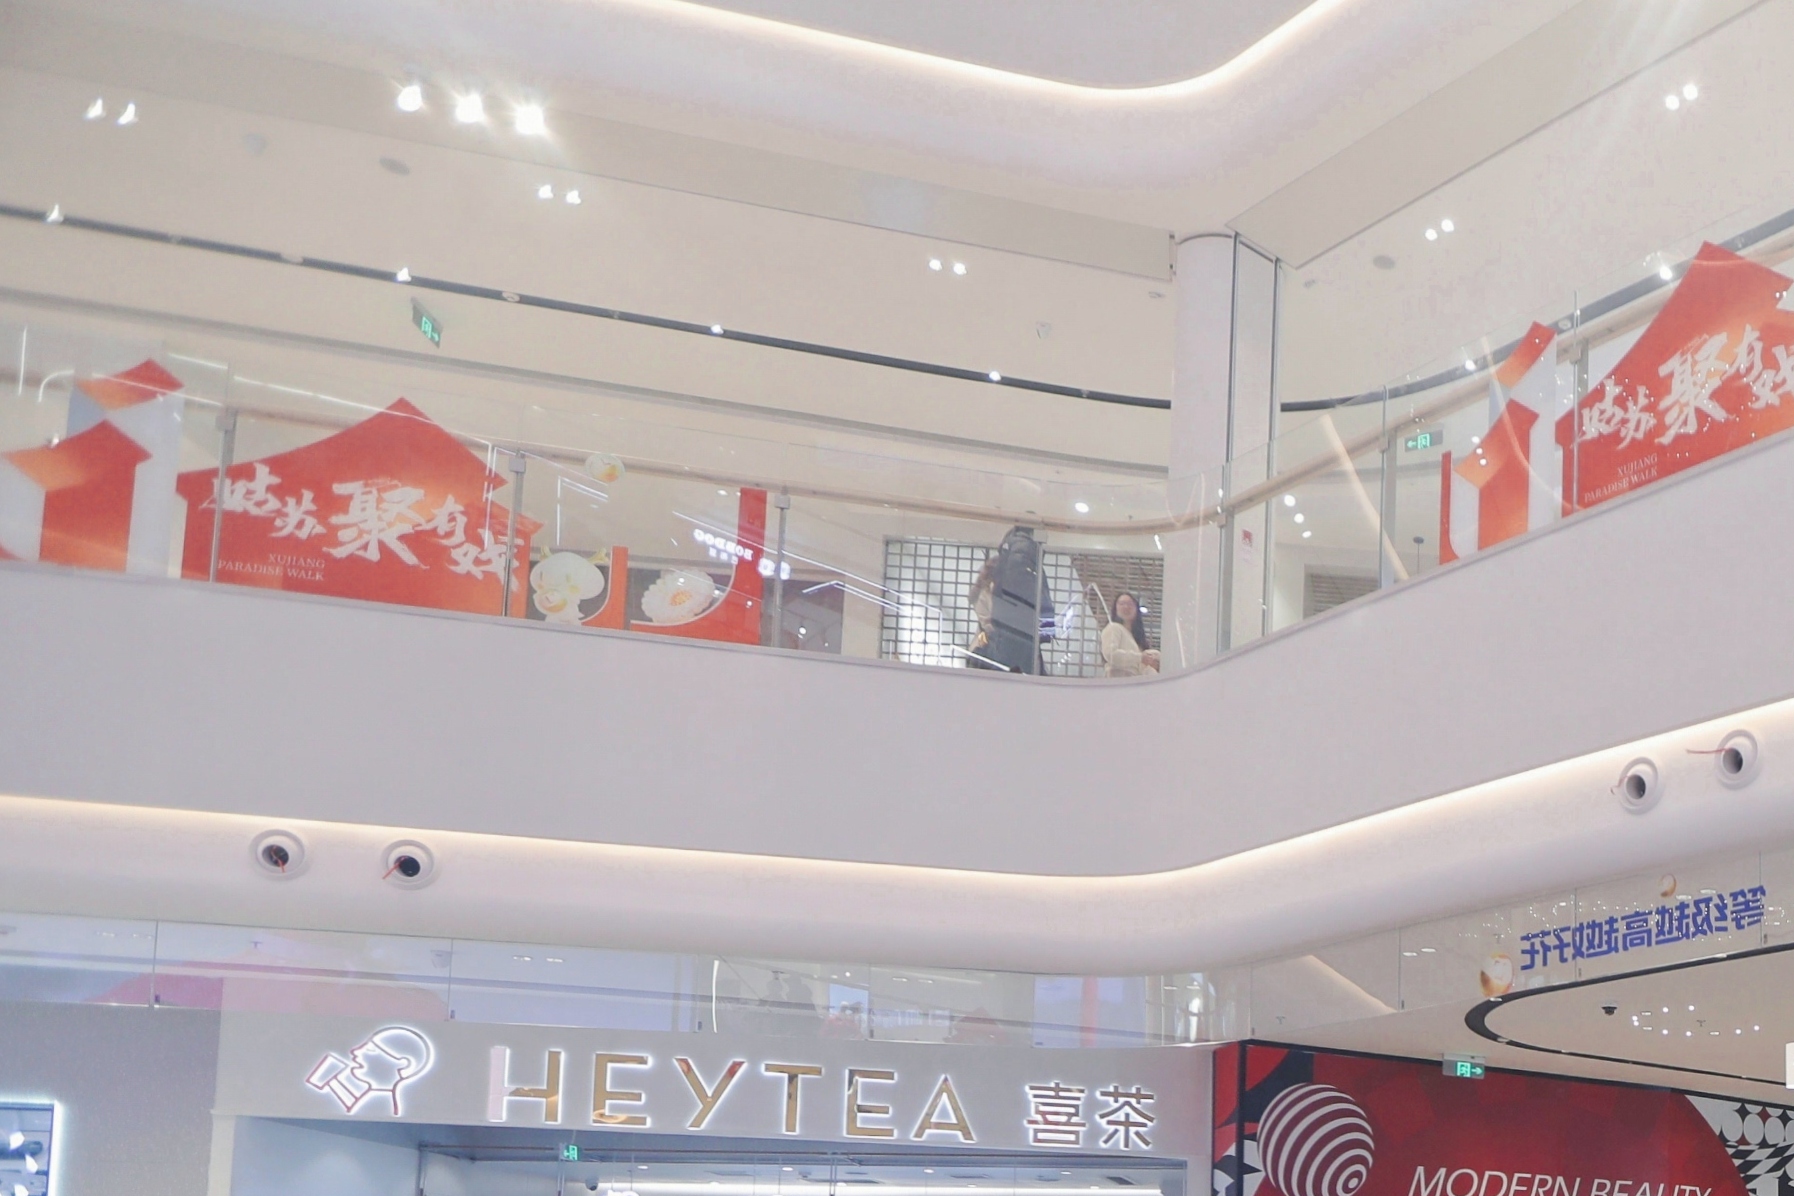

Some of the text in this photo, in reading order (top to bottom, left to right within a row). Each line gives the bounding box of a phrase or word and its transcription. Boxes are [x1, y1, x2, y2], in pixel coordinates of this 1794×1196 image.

[1616, 453, 1659, 477] XUJIANG
[1584, 466, 1659, 503] PARADISE WALK
[218, 559, 326, 581] PARADISE WALK
[268, 553, 326, 569] XUJIANG
[489, 1045, 977, 1144] HEYTEA
[1024, 1080, 1157, 1151] 喜茶
